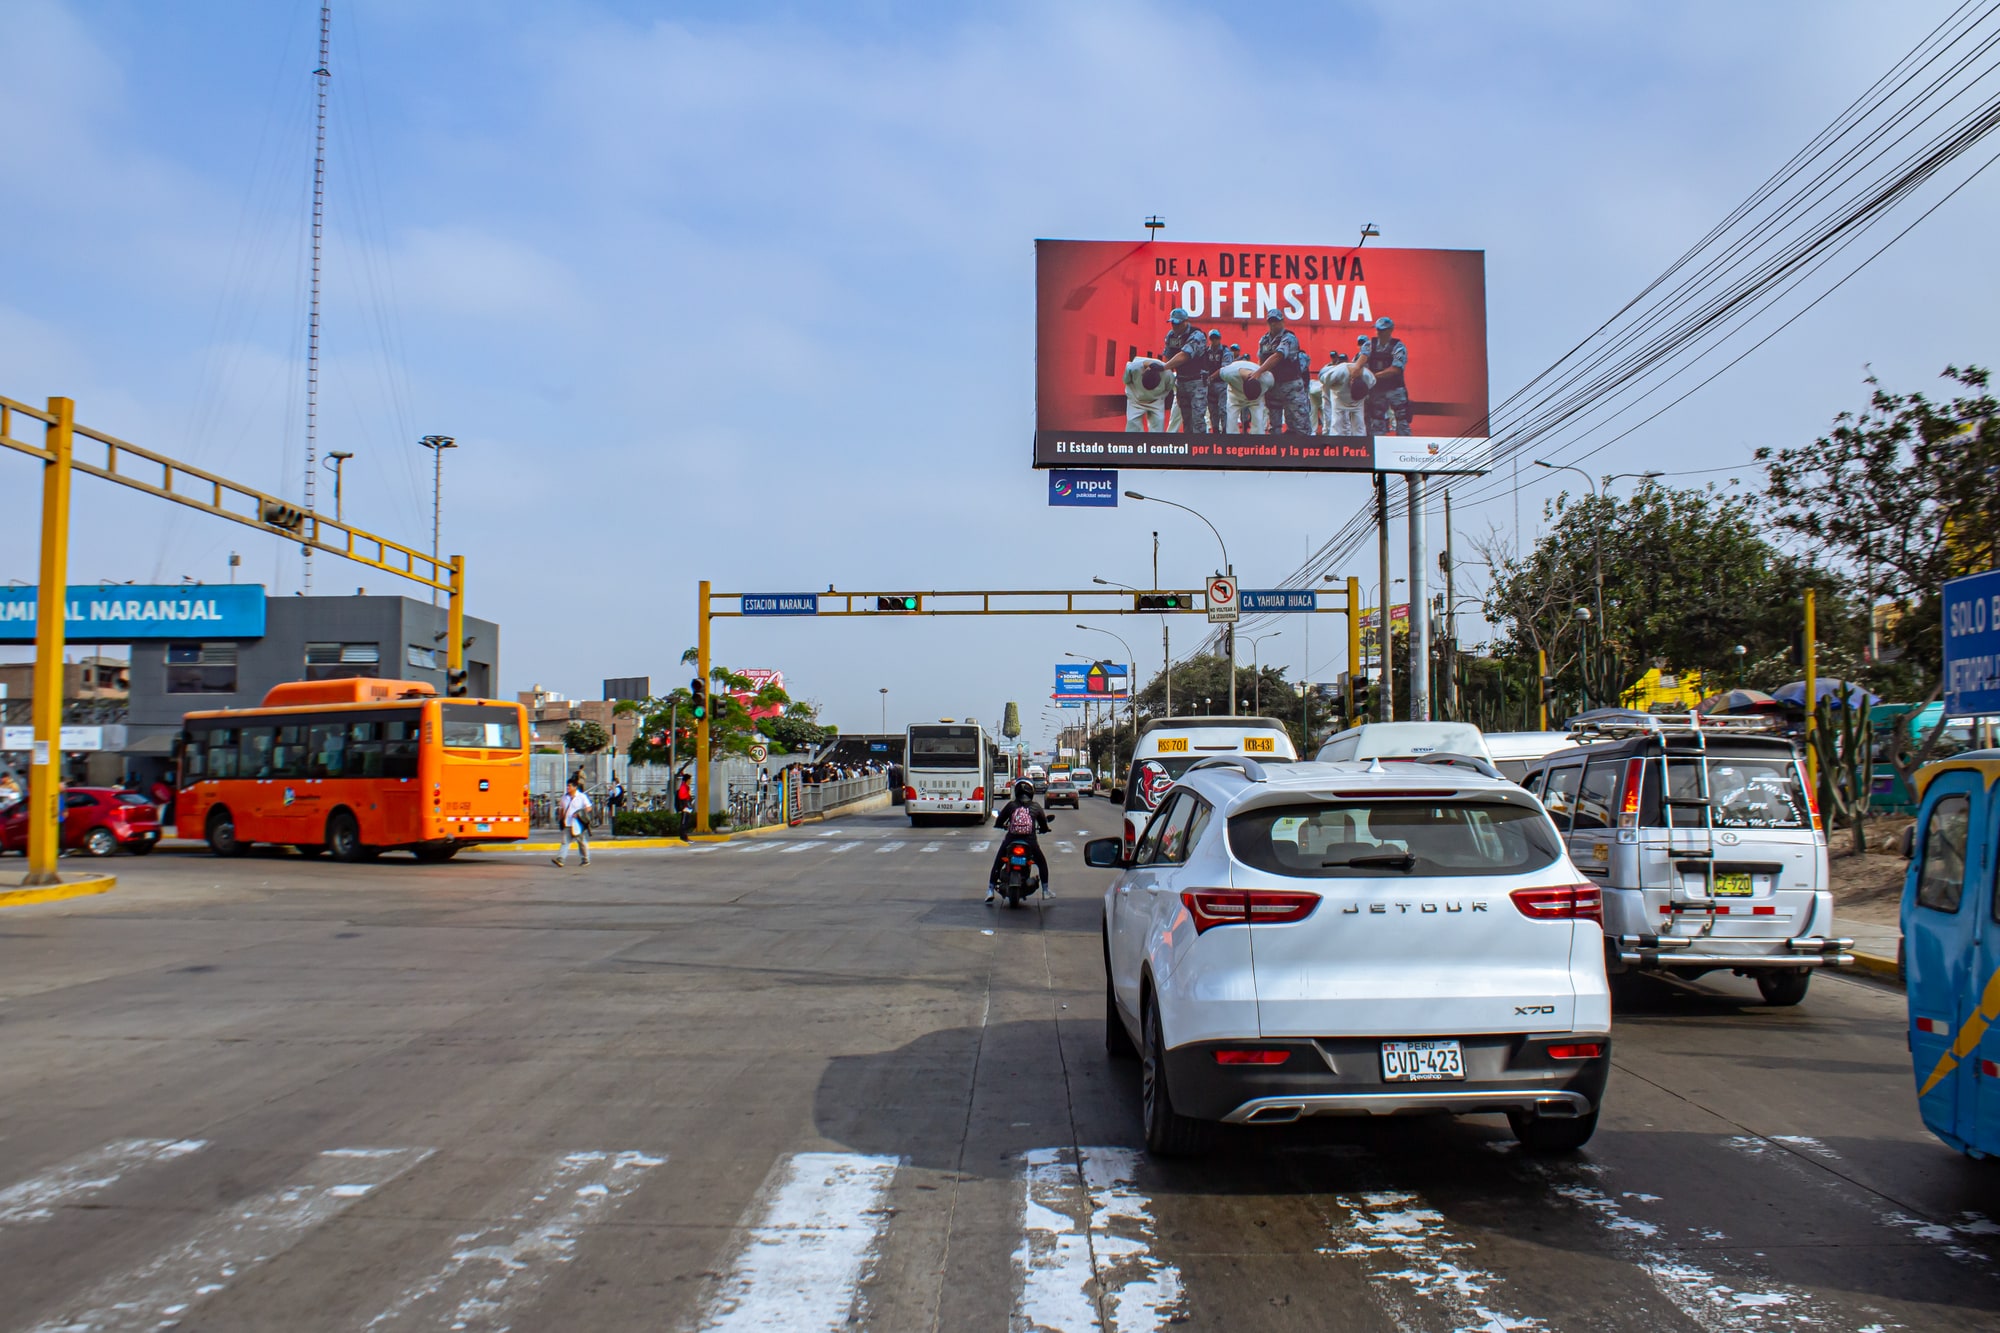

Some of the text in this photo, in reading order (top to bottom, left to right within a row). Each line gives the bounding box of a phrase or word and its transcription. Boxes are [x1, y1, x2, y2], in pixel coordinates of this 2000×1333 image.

[1155, 253, 1365, 281] DE LA DEFENSIVA
[1154, 279, 1373, 322] A LA OFENSIVA
[1056, 441, 1370, 459] El Estado toma el control por la seguridad y la paz del Perú.
[1399, 455, 1435, 463] Gobierno
[1436, 455, 1448, 463] del
[1076, 479, 1112, 497] input
[745, 598, 814, 610] ESTACION NARANJAL
[1257, 595, 1285, 608] YAHUAR
[1288, 594, 1313, 607] HUACA
[90, 600, 223, 621] NARANJAL
[1950, 597, 1986, 638] SOLO
[1171, 739, 1187, 751] 701
[1710, 876, 1750, 890] CZ-920
[1342, 900, 1489, 914] JETOUR
[1514, 1005, 1555, 1016] X70
[1407, 1041, 1436, 1051] PERU
[1385, 1049, 1460, 1074] CVD-423
